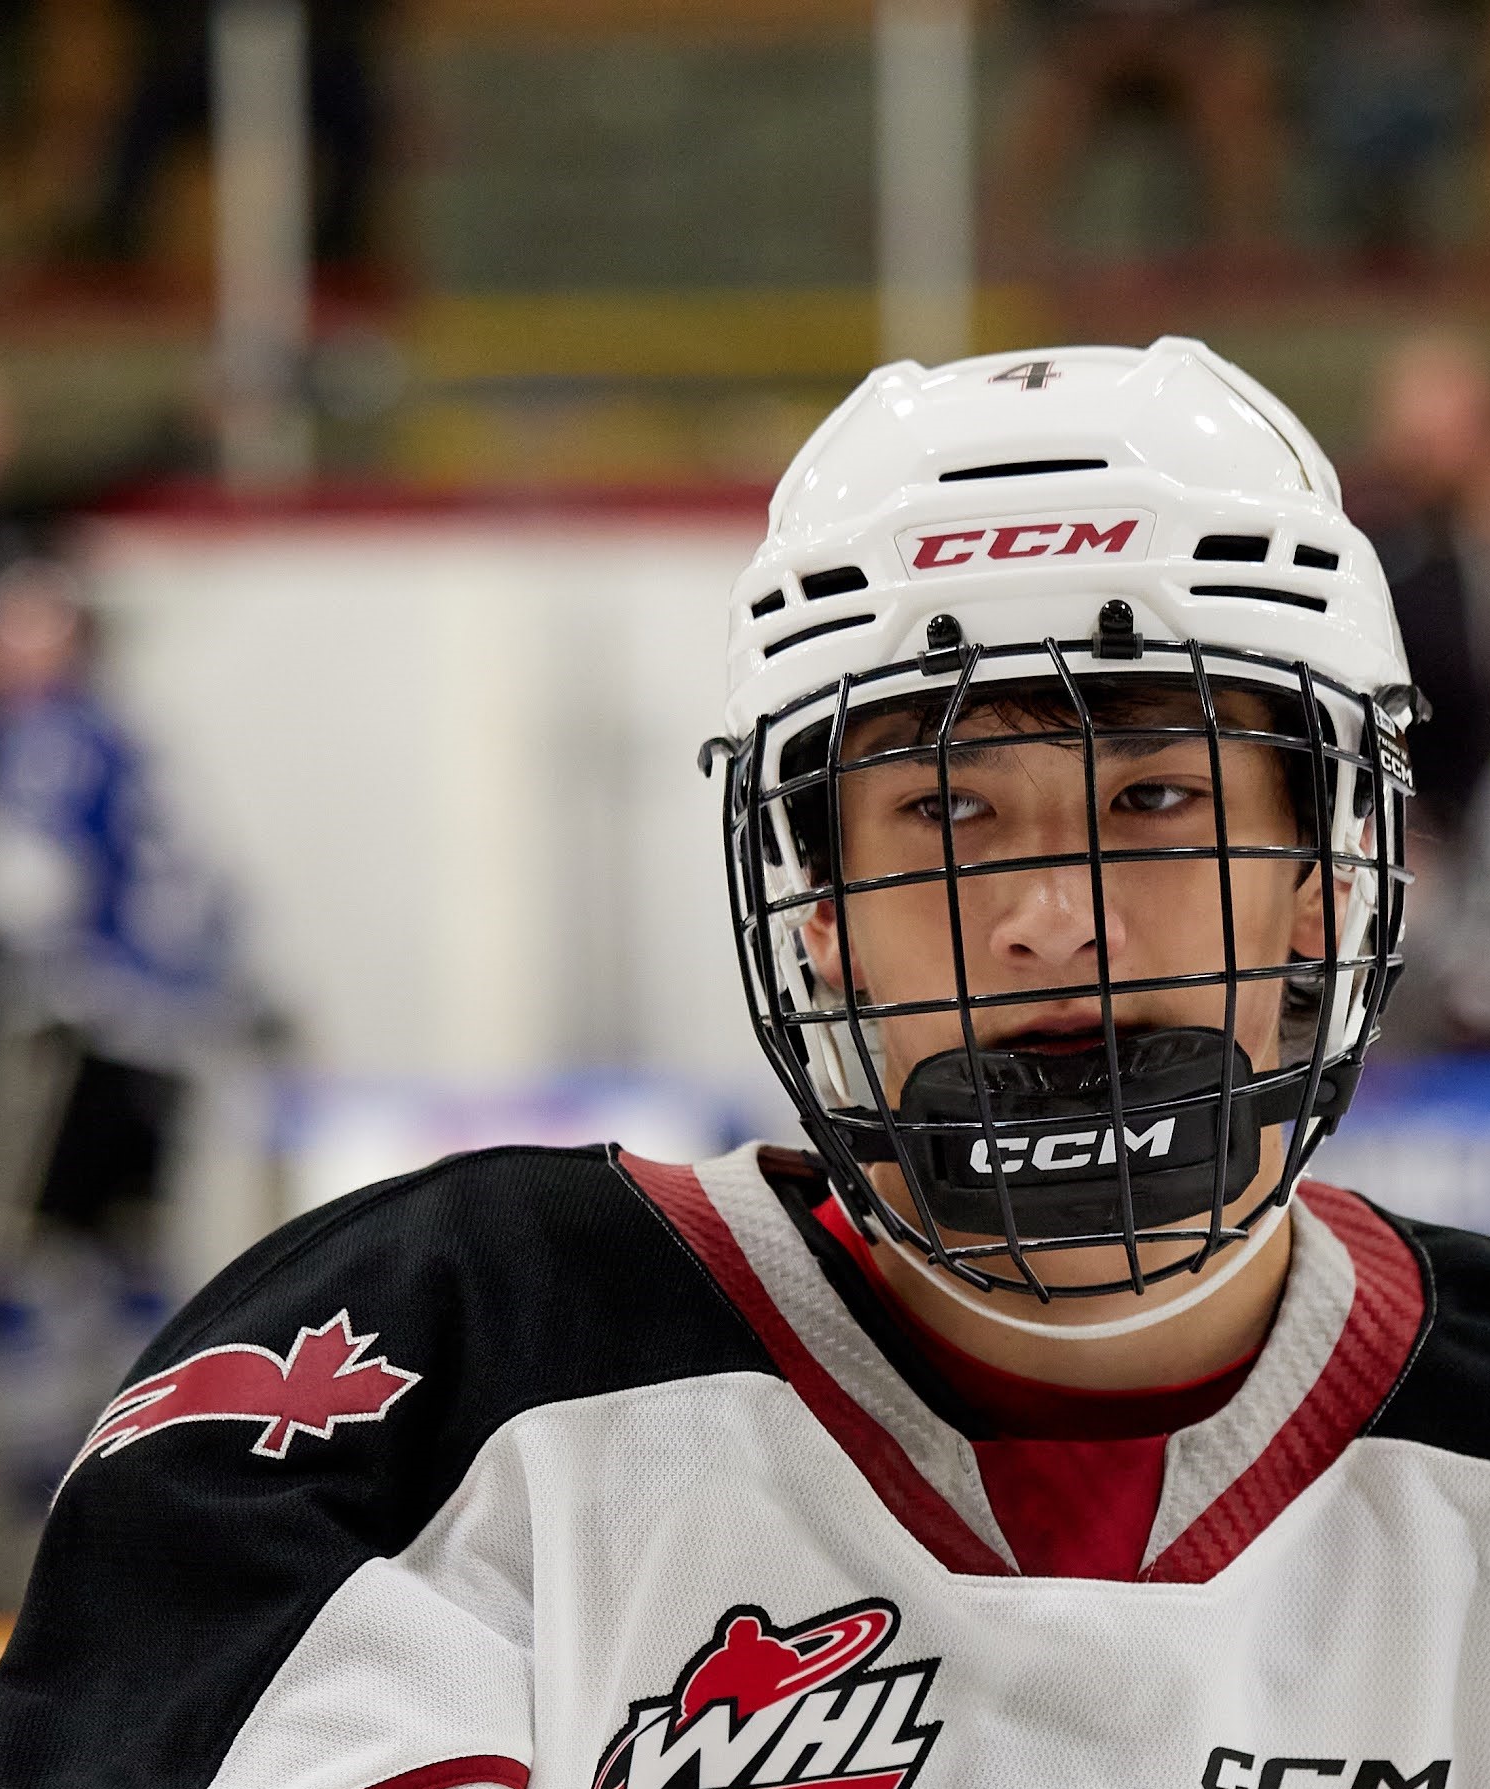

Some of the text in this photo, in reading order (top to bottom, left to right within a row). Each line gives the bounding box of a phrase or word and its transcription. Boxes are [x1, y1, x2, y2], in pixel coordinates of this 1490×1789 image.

[987, 361, 1062, 391] 4
[912, 519, 1140, 570] CCM
[1380, 749, 1414, 787] CCM
[969, 1117, 1176, 1174] CCM
